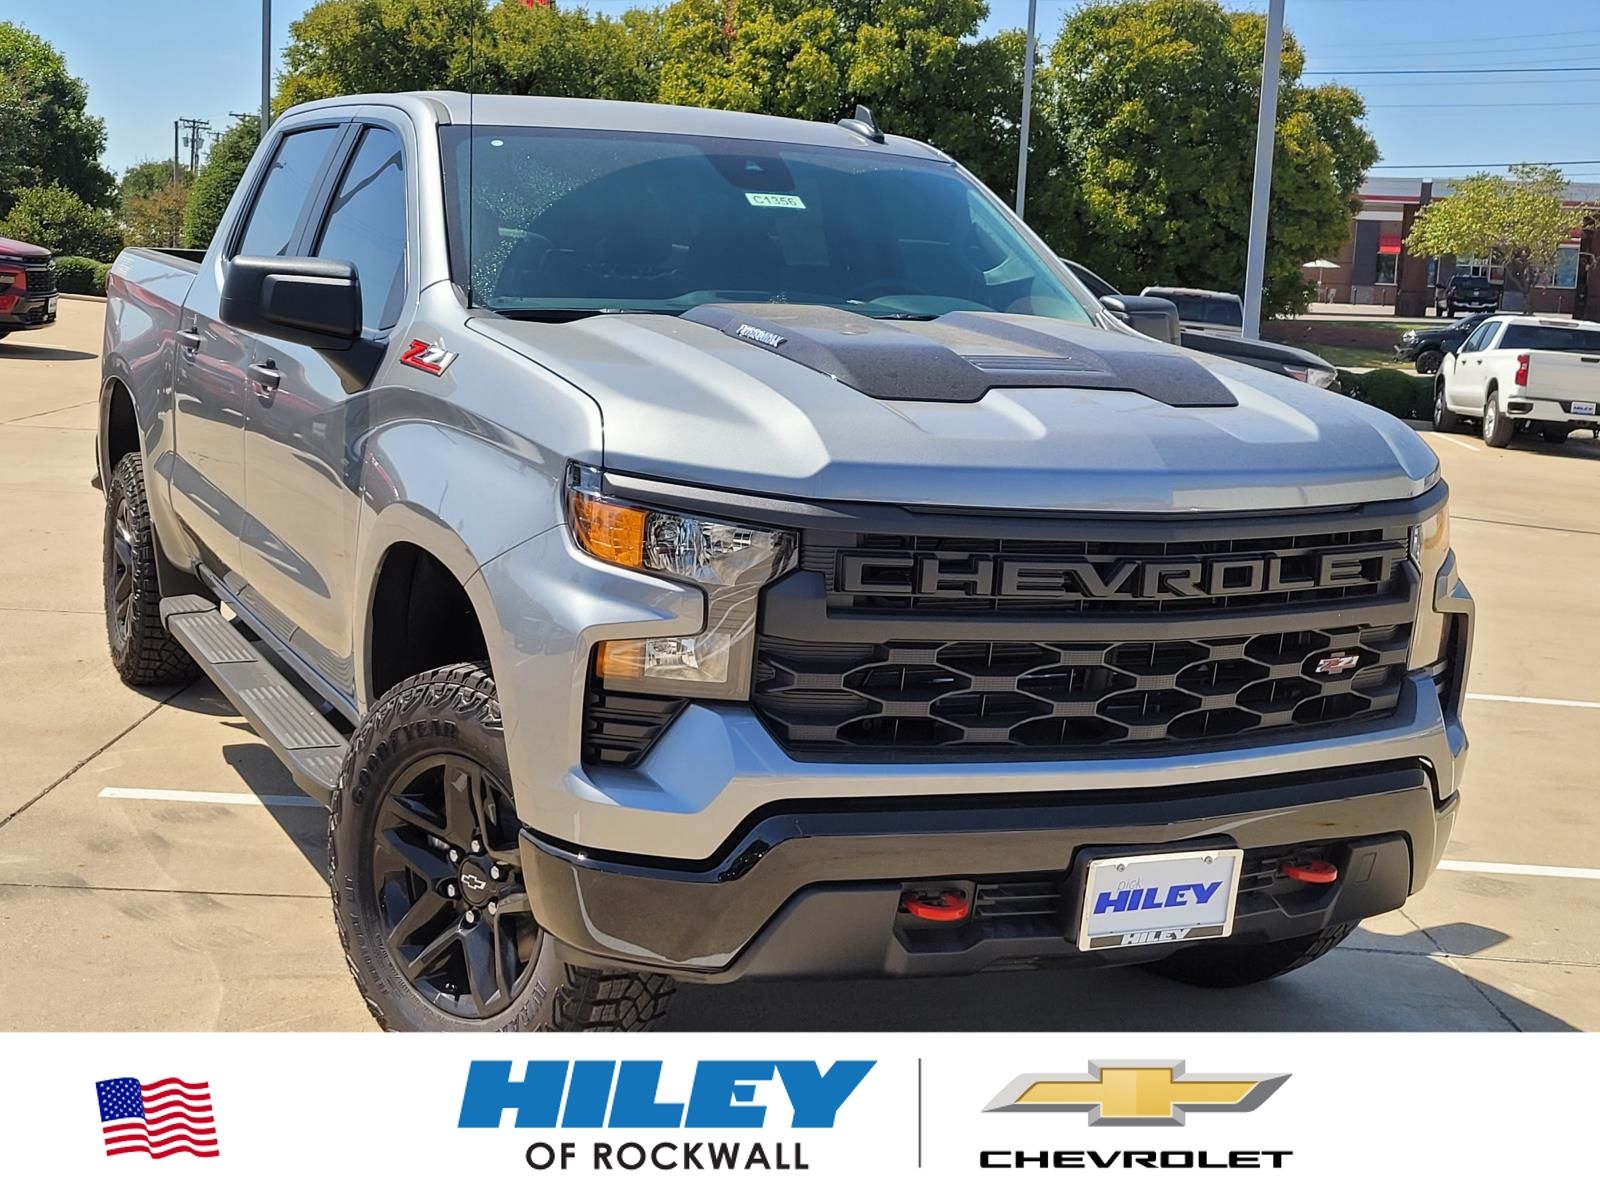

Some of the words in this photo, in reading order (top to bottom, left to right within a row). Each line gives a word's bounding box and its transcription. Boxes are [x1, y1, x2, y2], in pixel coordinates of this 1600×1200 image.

[752, 195, 798, 206] C1356
[843, 547, 1407, 598] CHEVROLET
[1093, 880, 1224, 915] HILEY
[1121, 928, 1191, 945] HILEY
